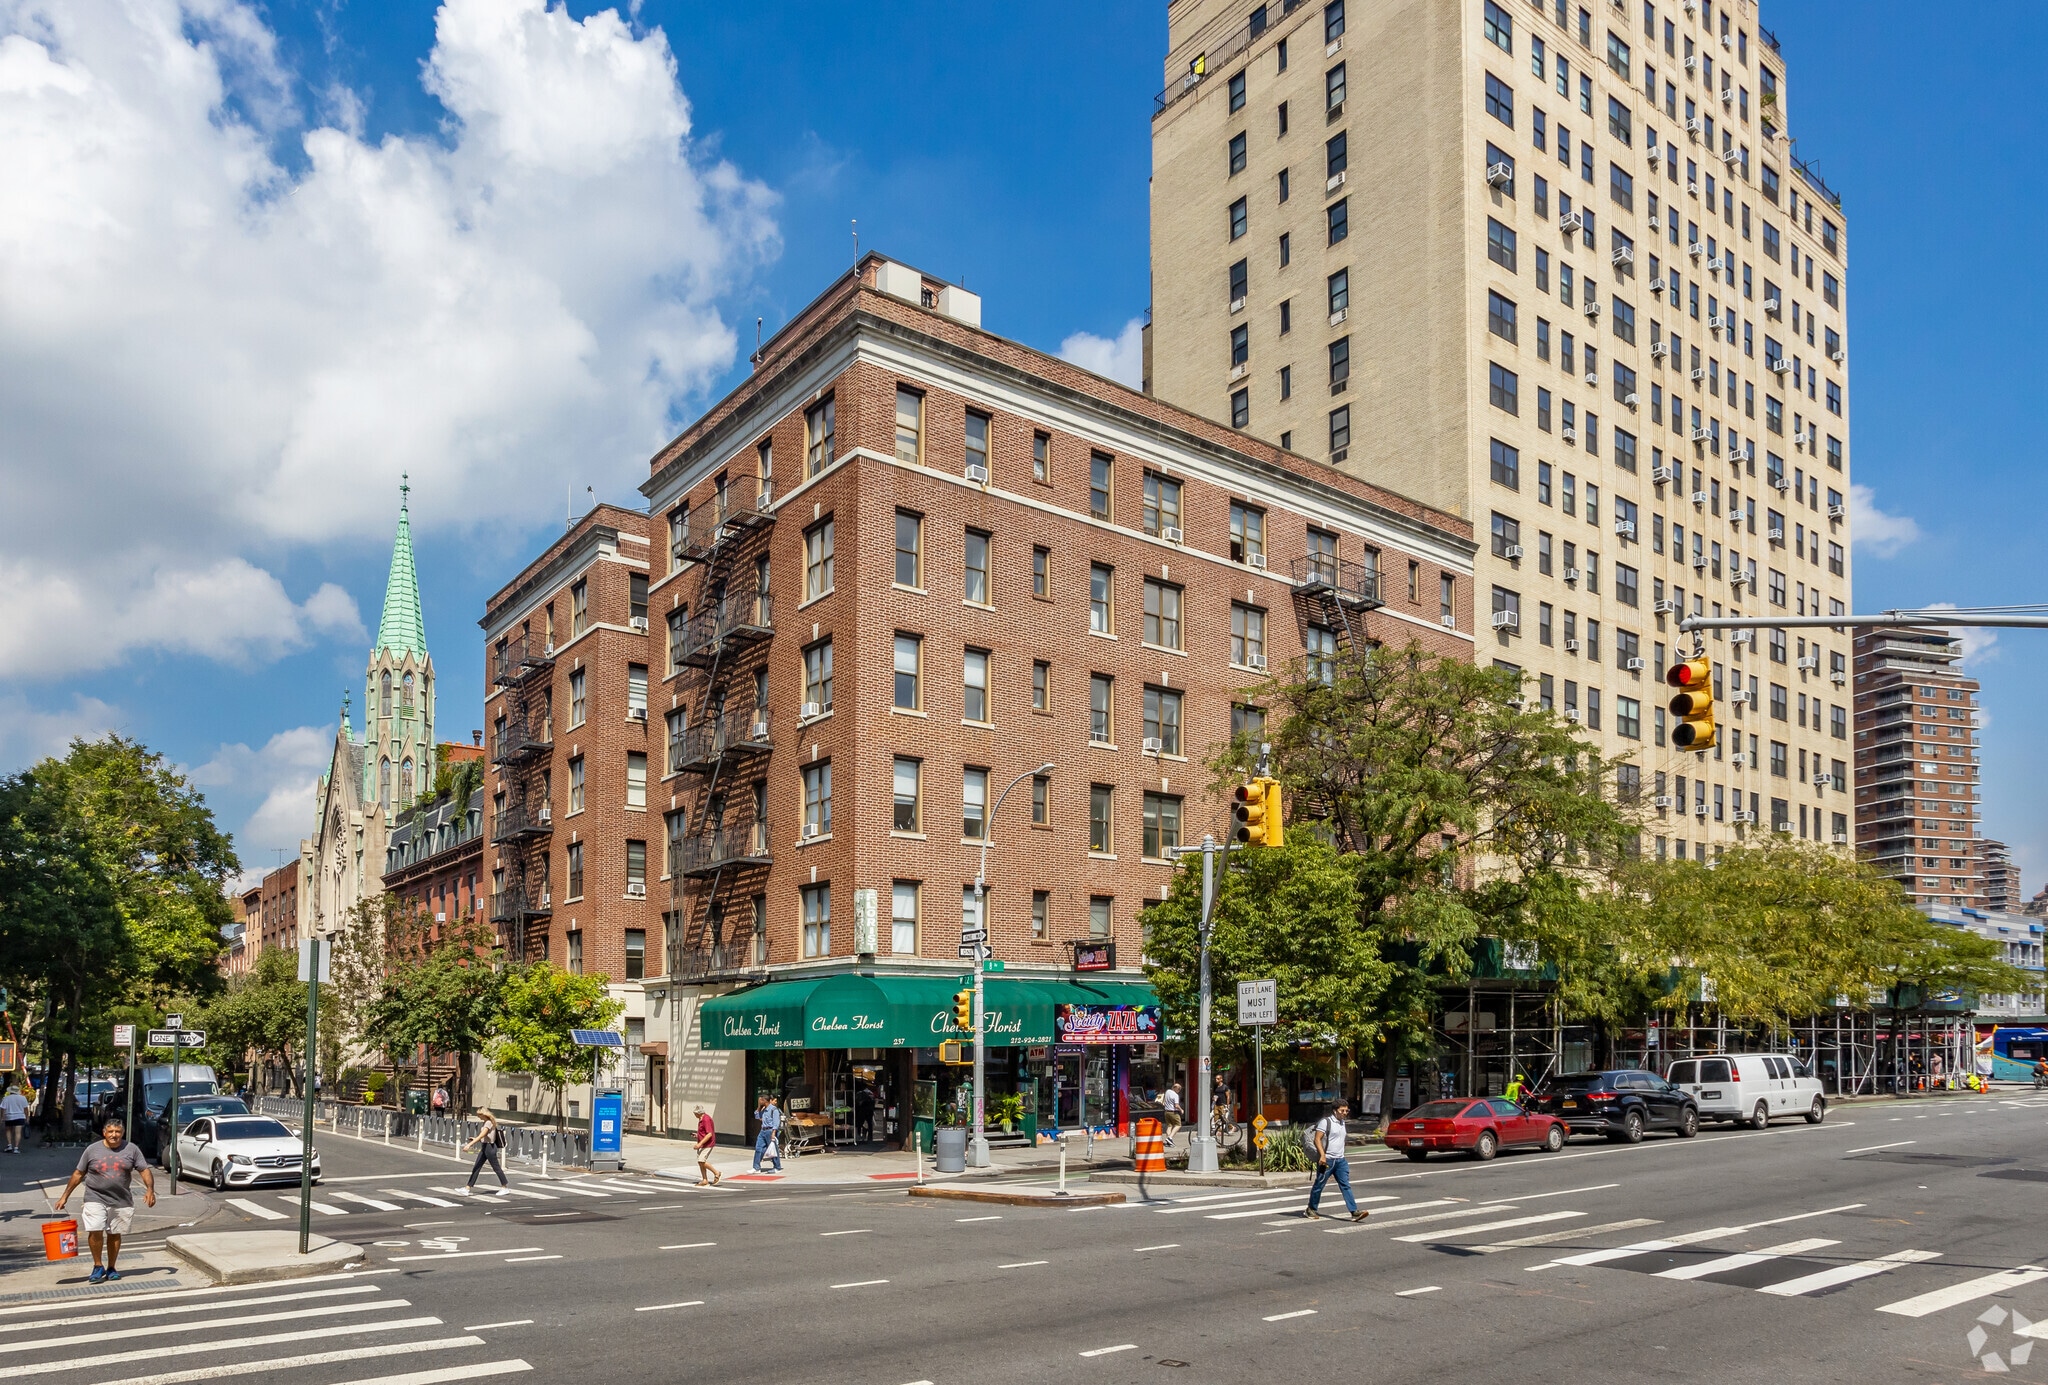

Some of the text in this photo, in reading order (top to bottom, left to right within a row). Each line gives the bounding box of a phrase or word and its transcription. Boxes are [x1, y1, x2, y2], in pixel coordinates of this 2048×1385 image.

[866, 892, 877, 951] FLORIST
[1241, 986, 1272, 995] LEFT LANE
[1247, 998, 1267, 1007] MUST
[1259, 1011, 1273, 1019] LEFT
[724, 1014, 781, 1037] Chelsea Florist
[812, 1015, 884, 1031] Chelsea Florist
[982, 1011, 1021, 1033] Florist
[1064, 1010, 1138, 1032] Society ZAZA
[153, 1034, 171, 1042] ONE
[893, 1038, 905, 1046] 237
[1010, 1036, 1051, 1044] 212-924-2821
[1029, 1048, 1045, 1057] ATM
